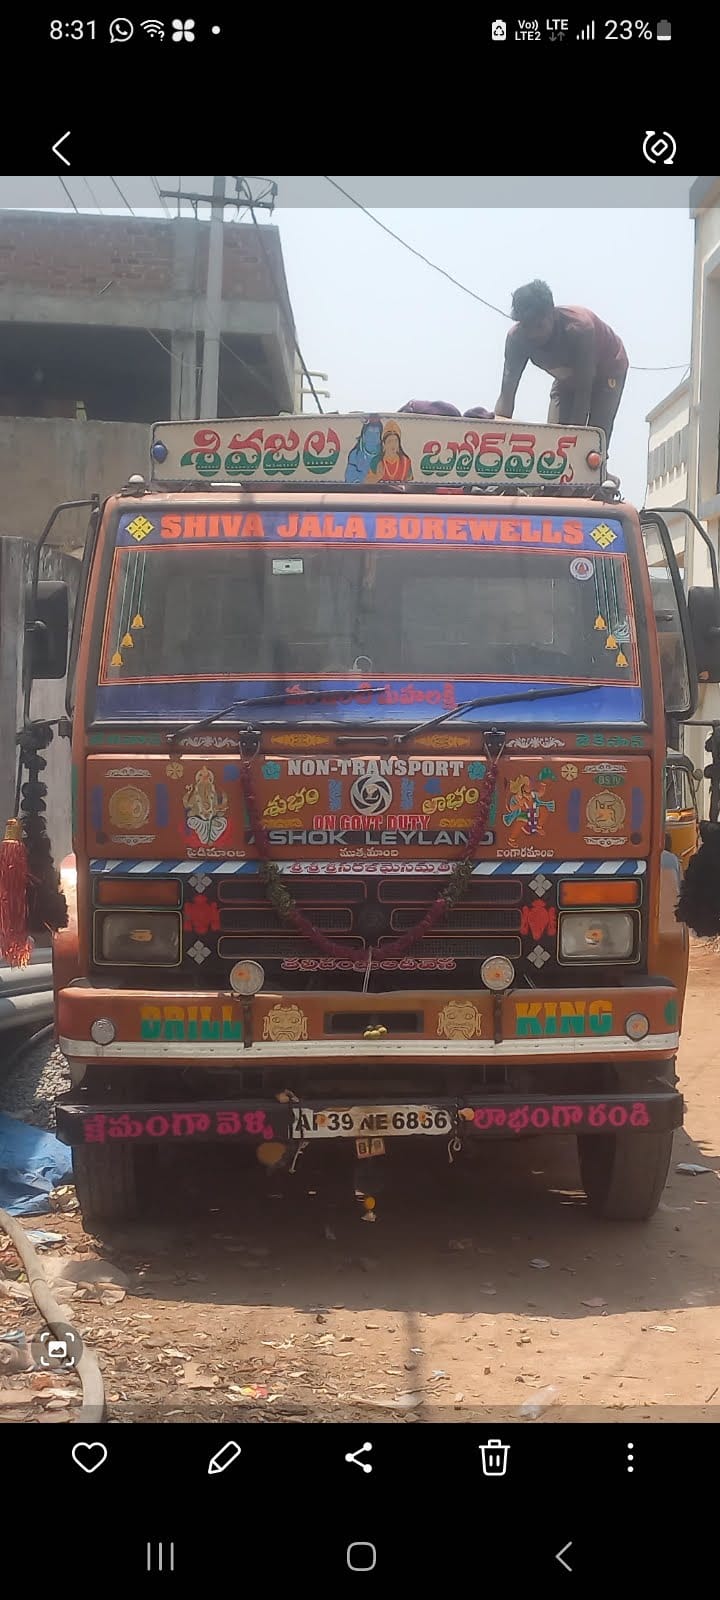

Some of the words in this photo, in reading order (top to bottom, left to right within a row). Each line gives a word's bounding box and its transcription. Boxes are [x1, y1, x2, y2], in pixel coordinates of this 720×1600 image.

[50, 20, 96, 40] 8:31
[546, 18, 569, 31] LTE
[604, 19, 653, 40] 23%
[514, 31, 541, 41] LTE2
[180, 427, 341, 478] శివజల
[160, 512, 266, 541] SHIVA
[276, 512, 368, 542] JALA
[375, 513, 586, 546] BOREWELLS
[287, 758, 464, 777] NON-TRANSPORT
[422, 786, 480, 815] లాభం
[312, 815, 337, 831] ON
[386, 815, 431, 831] DUTY
[141, 1006, 243, 1041] DRILL
[515, 1000, 614, 1036] KING
[327, 1113, 354, 1131] 39
